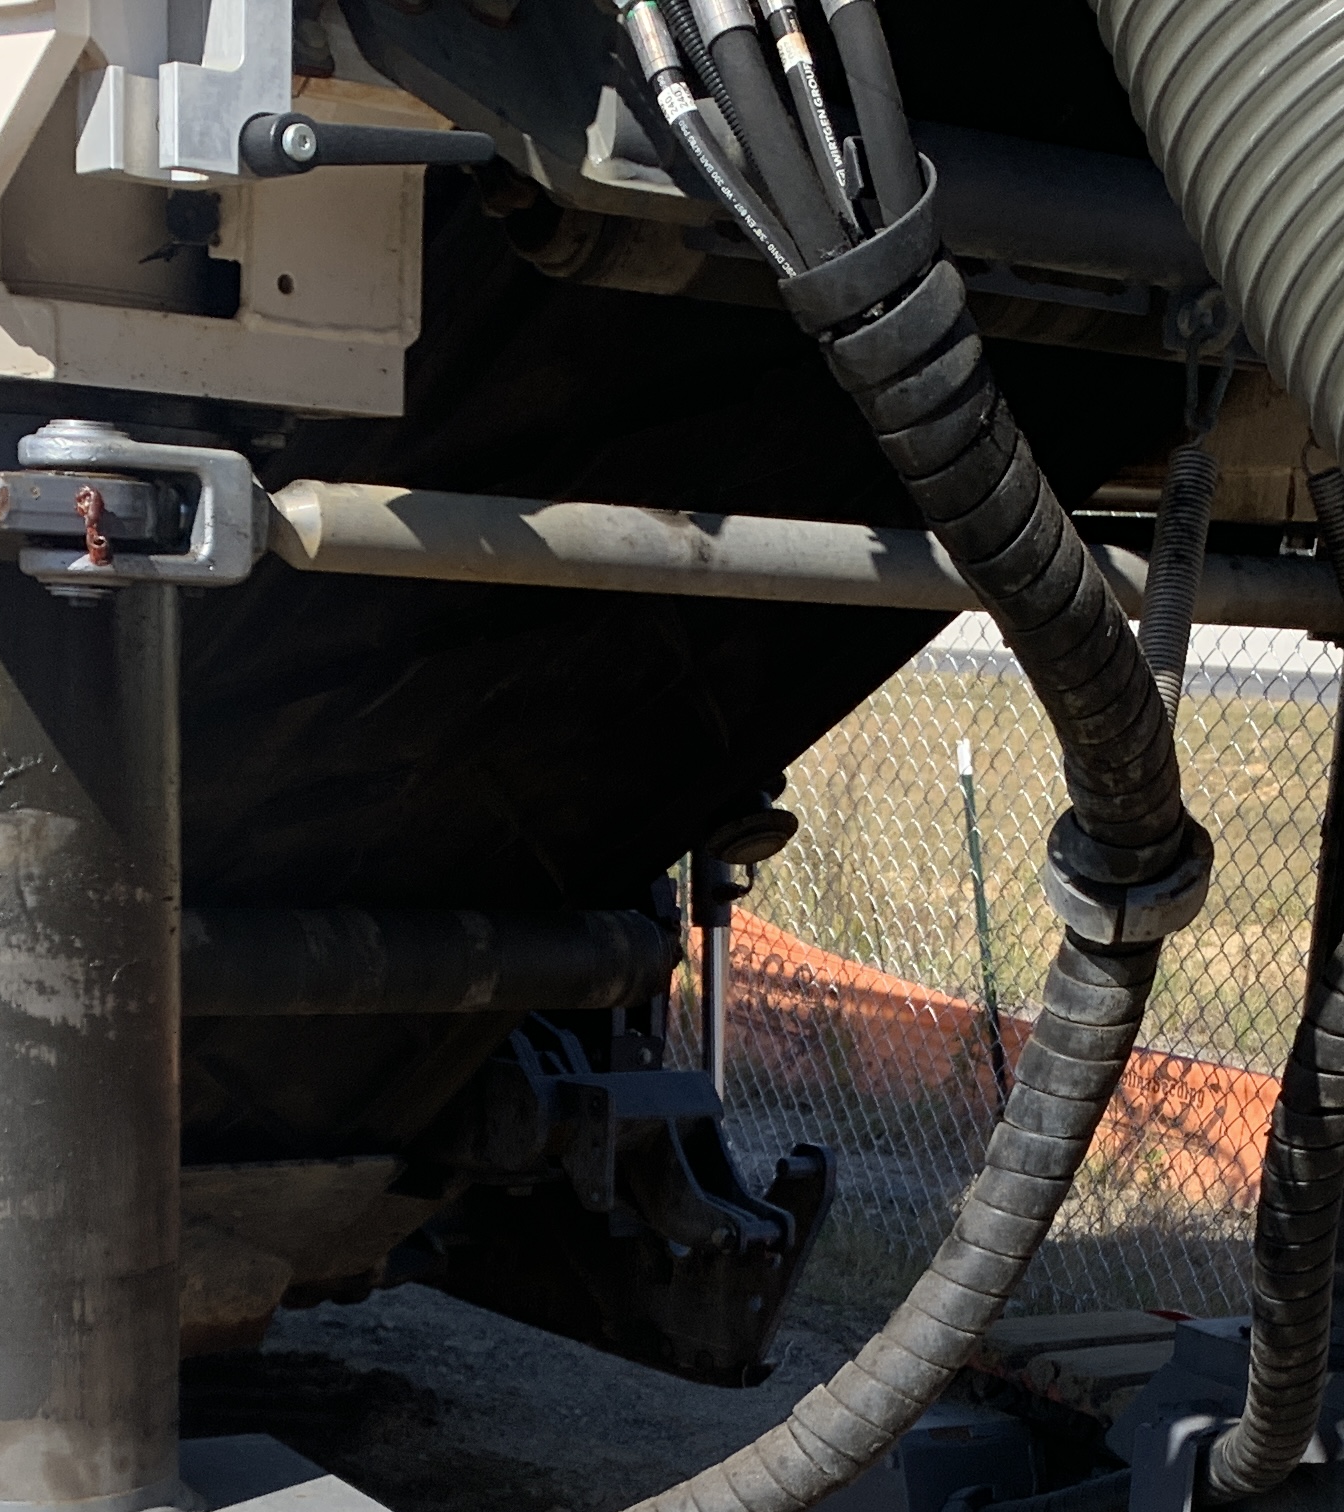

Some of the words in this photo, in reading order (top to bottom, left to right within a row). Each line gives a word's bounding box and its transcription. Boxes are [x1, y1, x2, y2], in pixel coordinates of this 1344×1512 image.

[817, 109, 843, 167] WIRTGEN
[699, 155, 715, 173] BAR
[721, 187, 734, 200] WP
[744, 215, 757, 229] EN
